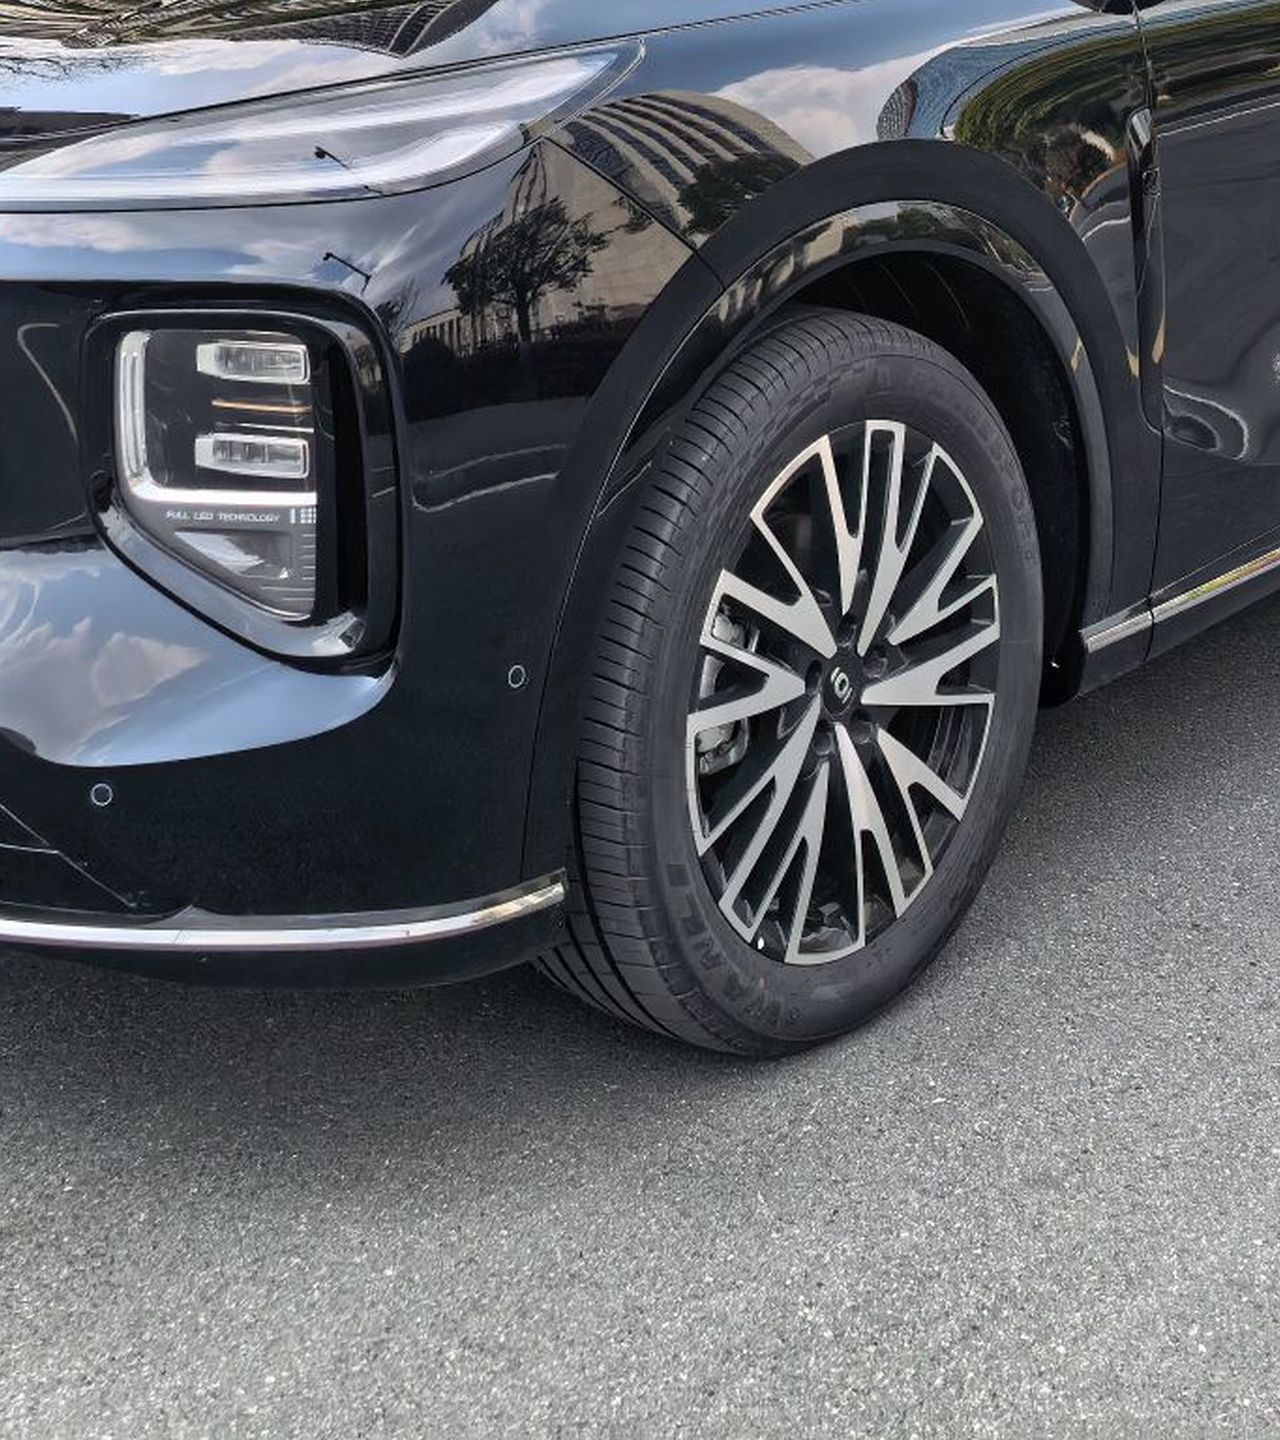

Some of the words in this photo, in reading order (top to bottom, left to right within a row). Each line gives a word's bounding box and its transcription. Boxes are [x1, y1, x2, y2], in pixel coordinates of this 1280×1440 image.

[166, 511, 190, 520] FULL
[193, 512, 214, 521] LED
[218, 512, 281, 522] TECHNOLOGY
